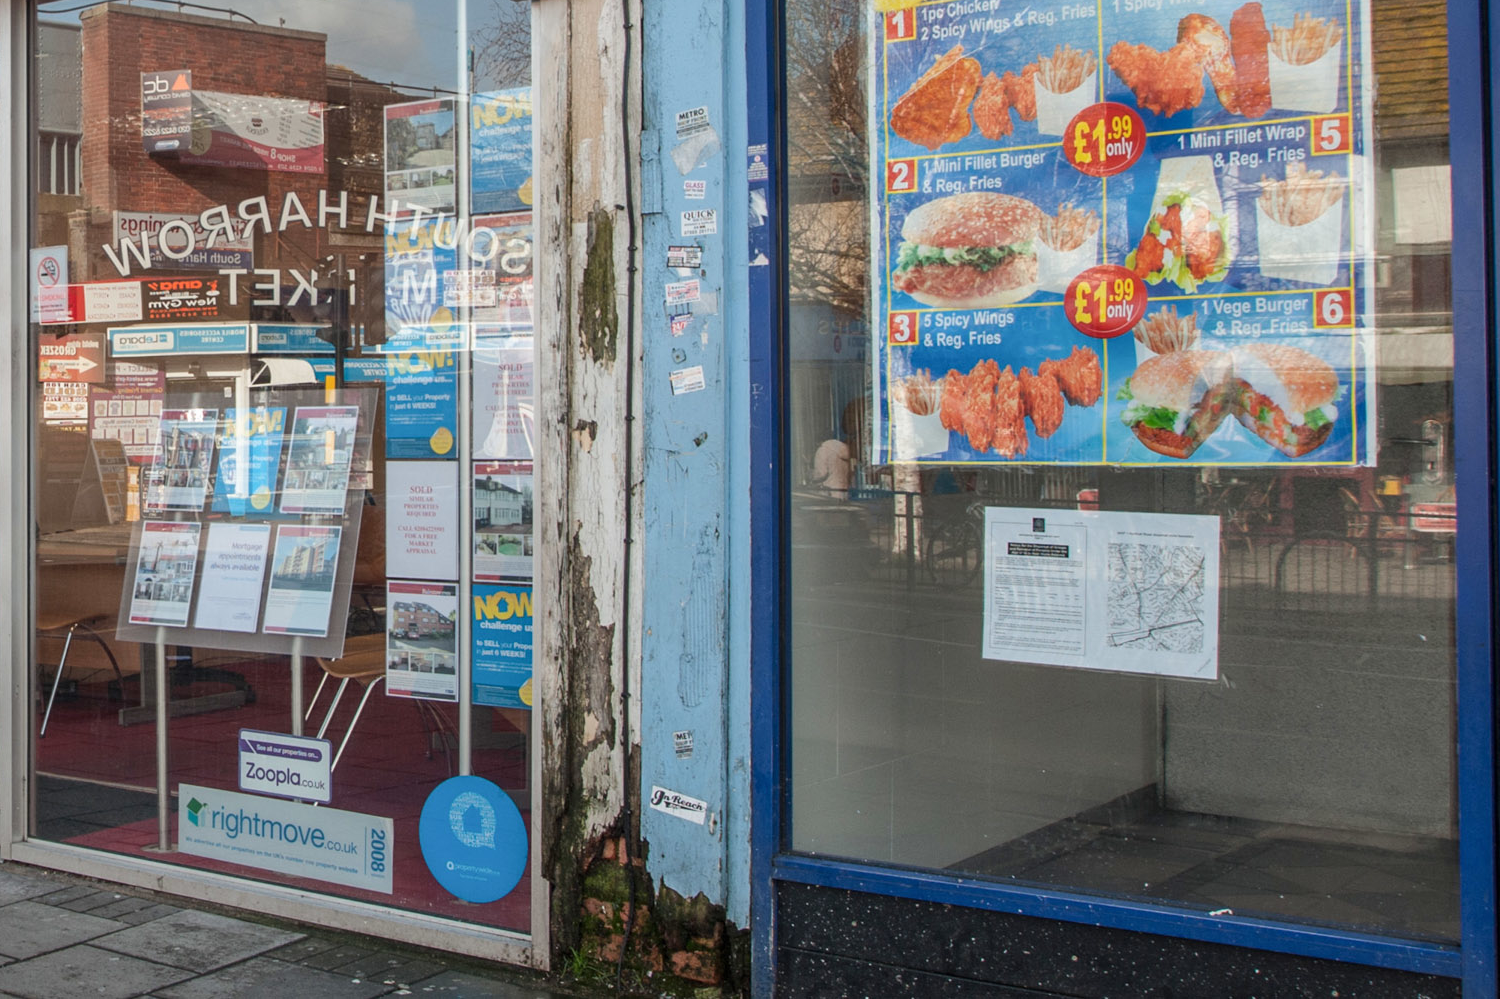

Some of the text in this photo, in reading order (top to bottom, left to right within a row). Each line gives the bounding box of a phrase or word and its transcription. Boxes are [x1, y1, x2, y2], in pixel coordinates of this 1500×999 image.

[947, 0, 1000, 18] Chicken
[891, 11, 905, 38] 1
[921, 3, 1096, 41] 2 Spicy Wings & Reg. Fries
[678, 108, 705, 121] METRO
[479, 124, 522, 138] challenge
[1073, 114, 1133, 164] £1.99
[1177, 124, 1306, 150] 1 Mini Fillet Wrap
[1320, 119, 1341, 150] 5
[1106, 137, 1133, 159] only
[1214, 146, 1306, 169] & Reg. Fries
[923, 152, 1046, 174] 1 Mini Fillet Burger
[891, 162, 909, 190] 2
[922, 175, 1002, 195] & Reg. Fries
[1074, 277, 1134, 325] £1.99
[1106, 300, 1134, 322] only
[1201, 296, 1309, 317] 1 Vege Burger
[1321, 293, 1344, 324] 6
[894, 314, 910, 342] 3
[924, 310, 1014, 330] 5 Spicy Wings
[1215, 318, 1308, 336] & Fries
[923, 331, 1002, 349] & Reg. Fries
[387, 346, 454, 377] NOW!
[498, 363, 523, 372] SOLD
[392, 376, 433, 385] challenge
[394, 402, 406, 411] just
[424, 394, 450, 402] Property
[409, 485, 433, 494] SOLD
[231, 541, 263, 552] Mortgage
[405, 547, 437, 555] APPRAISAL
[210, 561, 260, 572] always available
[218, 552, 262, 562] appointments
[480, 620, 523, 633] challenge
[481, 648, 494, 657] just
[484, 639, 500, 648] SELL
[256, 743, 266, 752] See
[273, 746, 282, 754] our
[282, 747, 308, 758] properties
[245, 762, 325, 791] Zoopla.co.uk
[671, 795, 703, 811] Reach
[211, 805, 358, 855] rightmove.co.uk
[193, 837, 215, 847] advertise
[231, 844, 256, 856] properties
[263, 849, 272, 857] the
[285, 854, 304, 864] number
[315, 861, 337, 872] property
[338, 863, 358, 874] website
[370, 828, 386, 873] 2008
